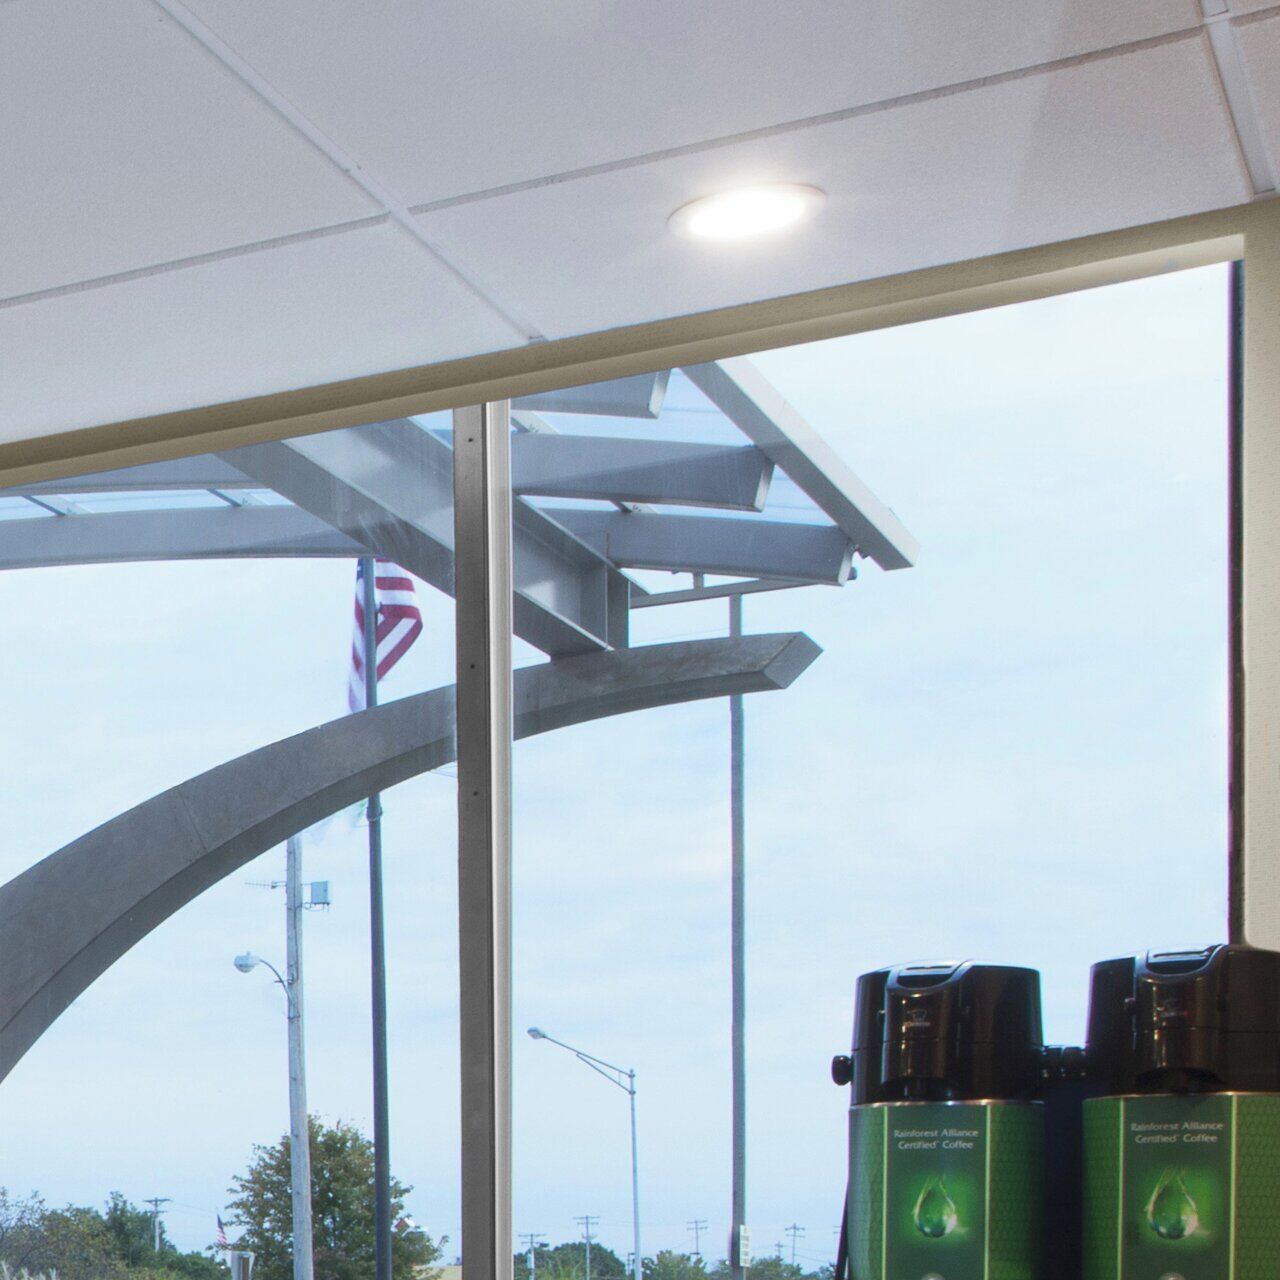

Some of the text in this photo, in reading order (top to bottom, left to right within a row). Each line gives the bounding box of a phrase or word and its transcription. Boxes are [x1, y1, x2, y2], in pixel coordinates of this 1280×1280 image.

[1130, 1120, 1224, 1132] Rainforest Alliance
[893, 1127, 979, 1139] Rainforest Alliance
[1134, 1132, 1219, 1144] Certified Coffee
[897, 1139, 975, 1150] Certified Coffee
